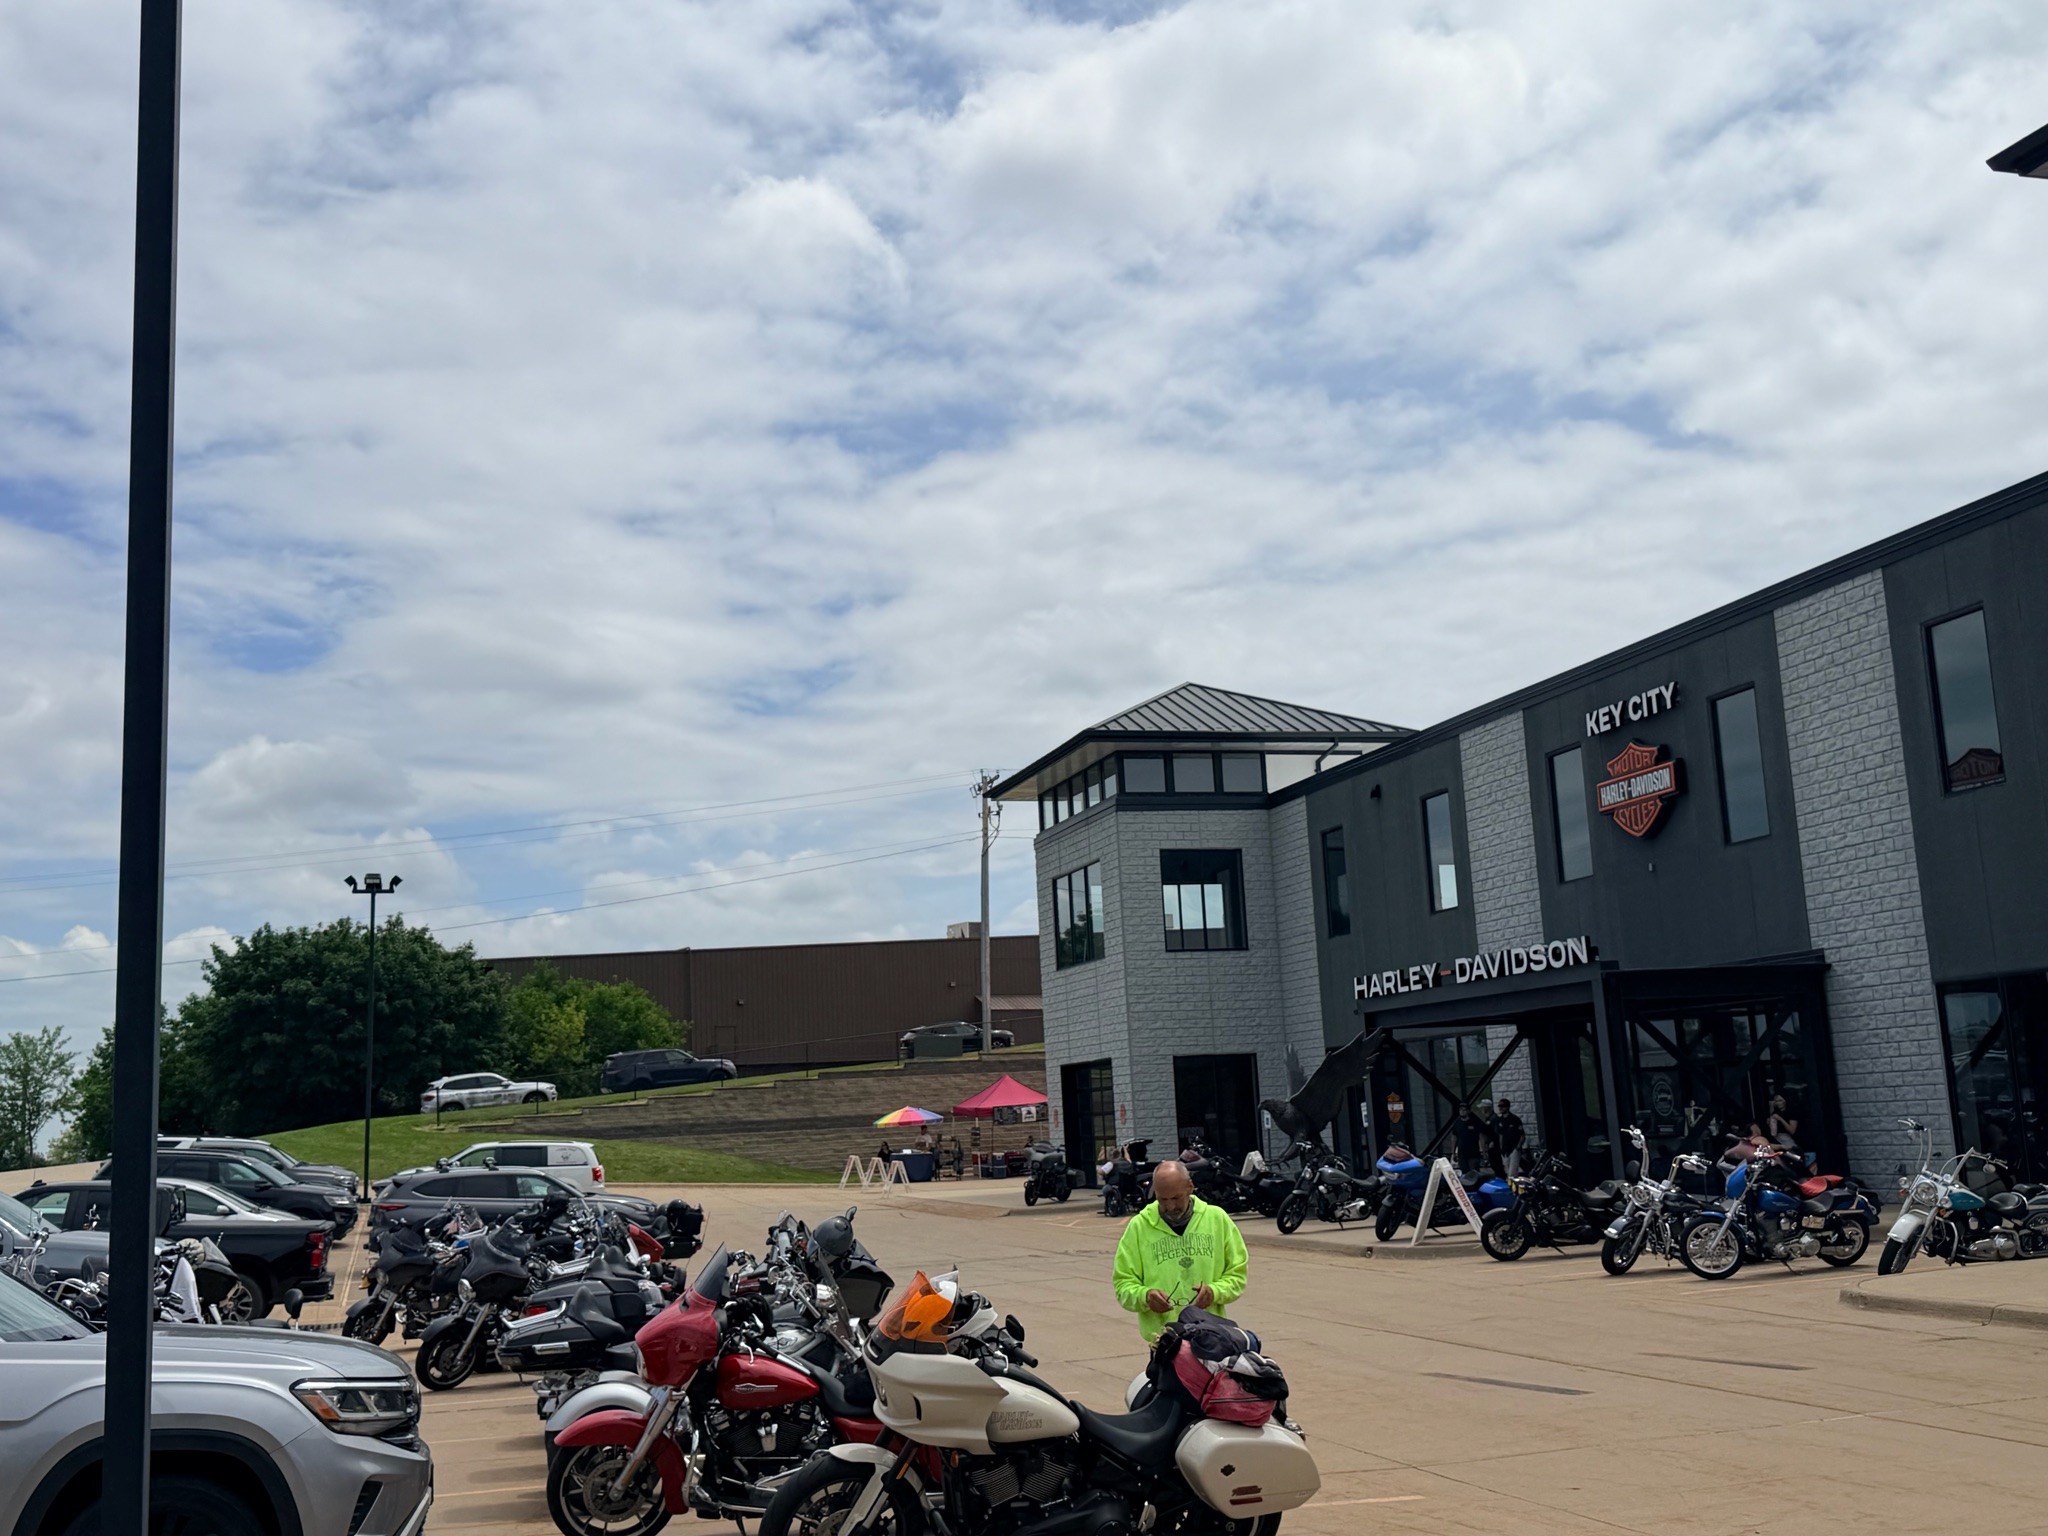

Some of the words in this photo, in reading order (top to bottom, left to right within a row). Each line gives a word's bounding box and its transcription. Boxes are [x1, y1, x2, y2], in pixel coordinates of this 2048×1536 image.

[1585, 700, 1623, 737] KEY
[1628, 681, 1675, 721] CITY
[1612, 748, 1651, 775] MOTOR
[1600, 767, 1671, 807] HARLEY-DAVIDSON
[1618, 800, 1655, 831] CYCLES
[1353, 935, 1589, 1000] HARLEY-DAVIDSON
[1156, 1247, 1214, 1266] LEGENDARY
